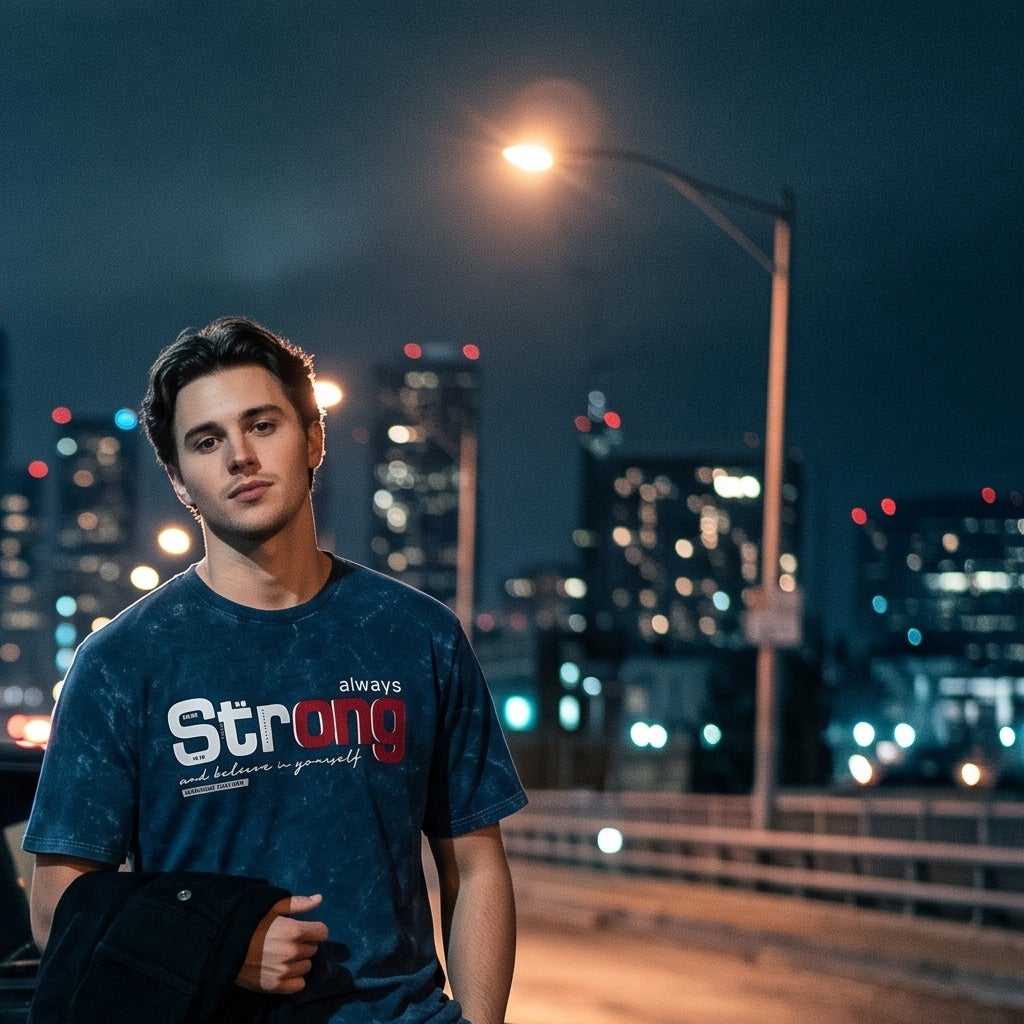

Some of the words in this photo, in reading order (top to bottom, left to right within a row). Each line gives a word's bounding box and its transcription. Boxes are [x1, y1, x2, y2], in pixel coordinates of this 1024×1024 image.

[339, 676, 402, 696] always
[167, 697, 406, 767] Strong
[179, 768, 210, 786] and
[294, 748, 362, 776] yourself
